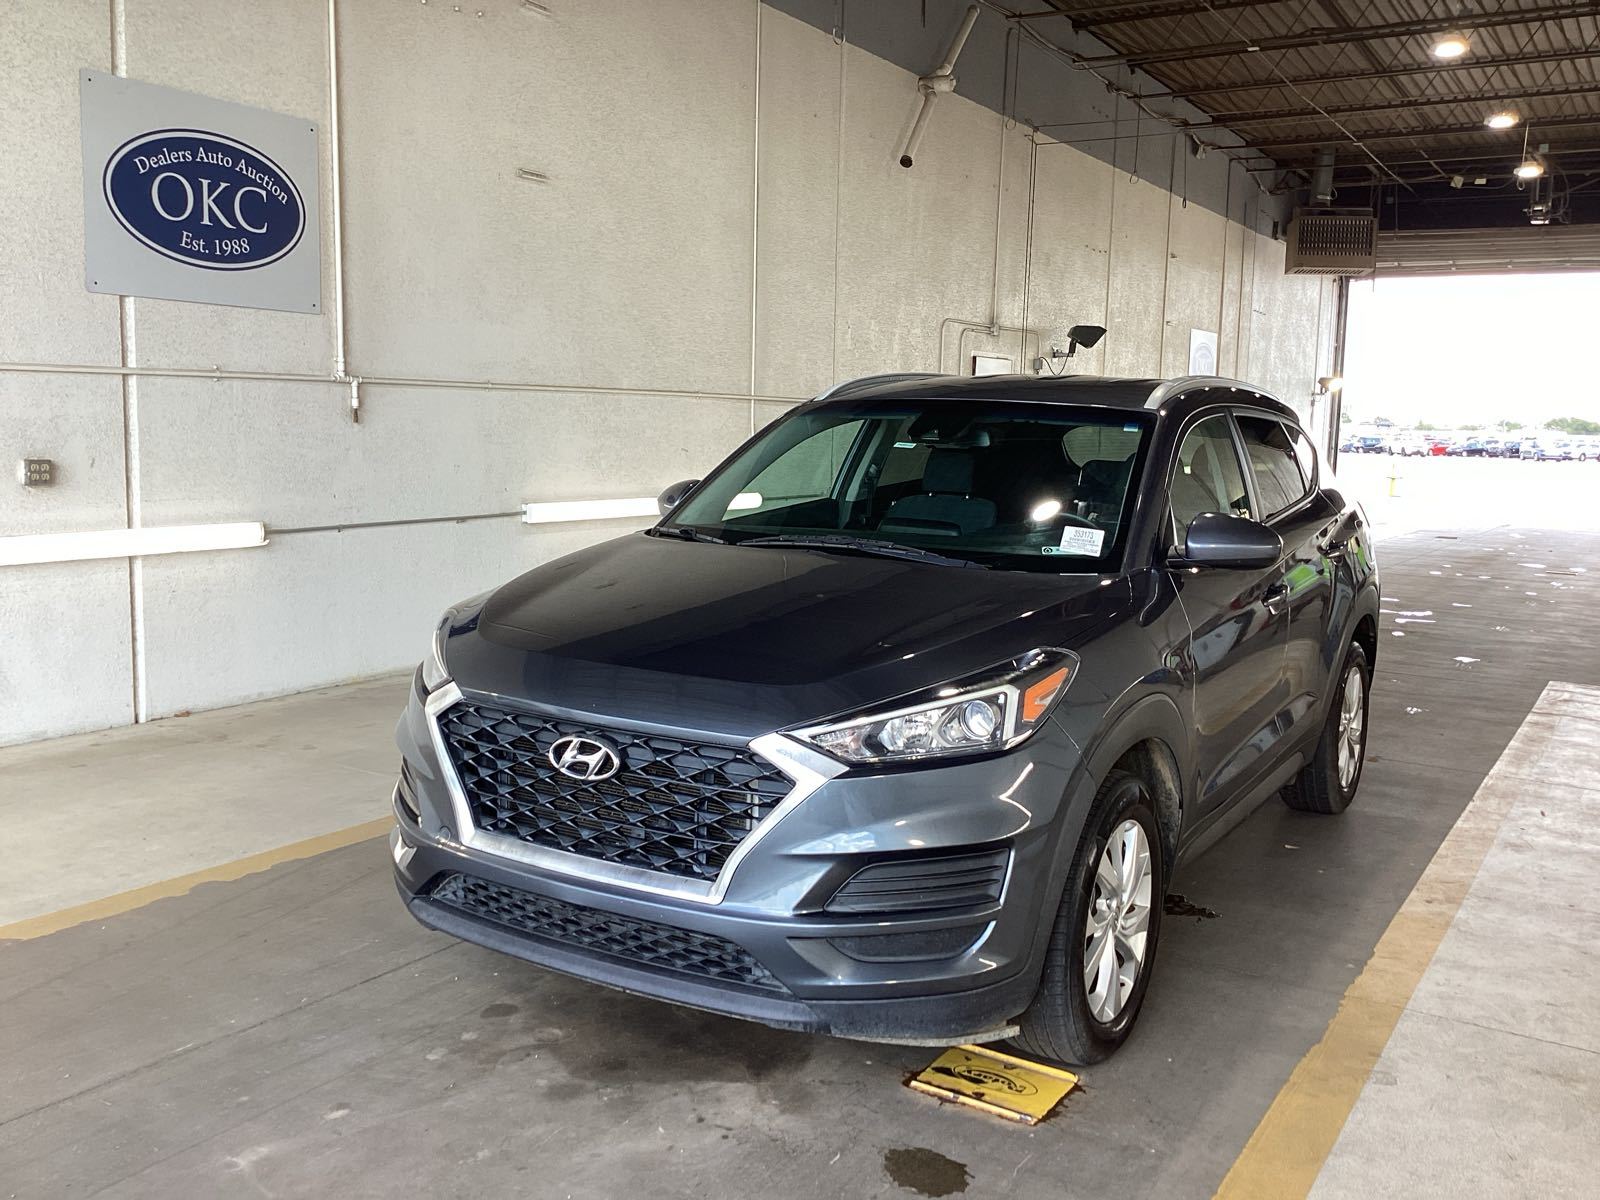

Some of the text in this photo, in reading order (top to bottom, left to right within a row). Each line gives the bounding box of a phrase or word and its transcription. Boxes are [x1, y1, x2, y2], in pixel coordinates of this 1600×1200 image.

[133, 147, 288, 204] Dealers Auto Auction
[151, 172, 268, 234] OKC
[179, 231, 250, 256] Est. 1988
